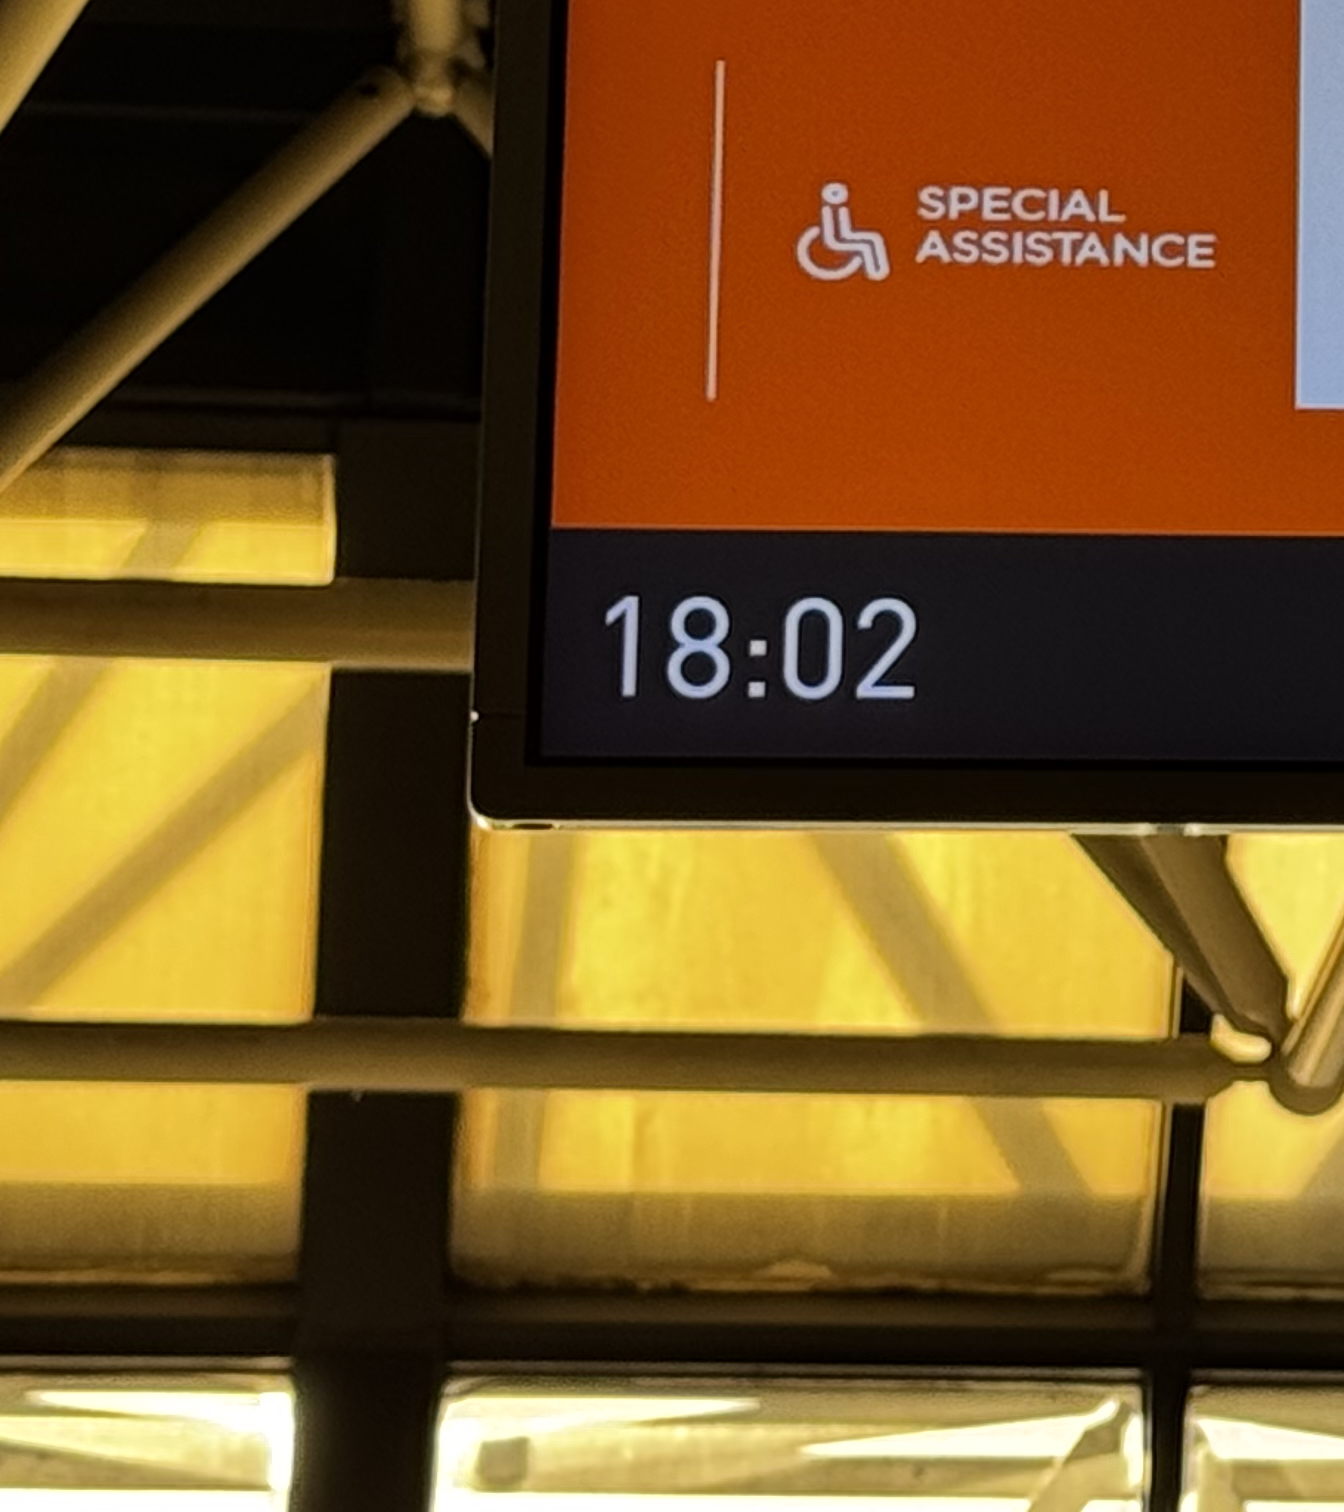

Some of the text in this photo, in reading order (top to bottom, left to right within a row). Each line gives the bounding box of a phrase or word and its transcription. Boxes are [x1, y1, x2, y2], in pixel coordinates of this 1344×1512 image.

[917, 185, 1127, 223] SPECIAL
[915, 230, 1218, 269] ASSISTANCE
[604, 595, 918, 701] 18:02
